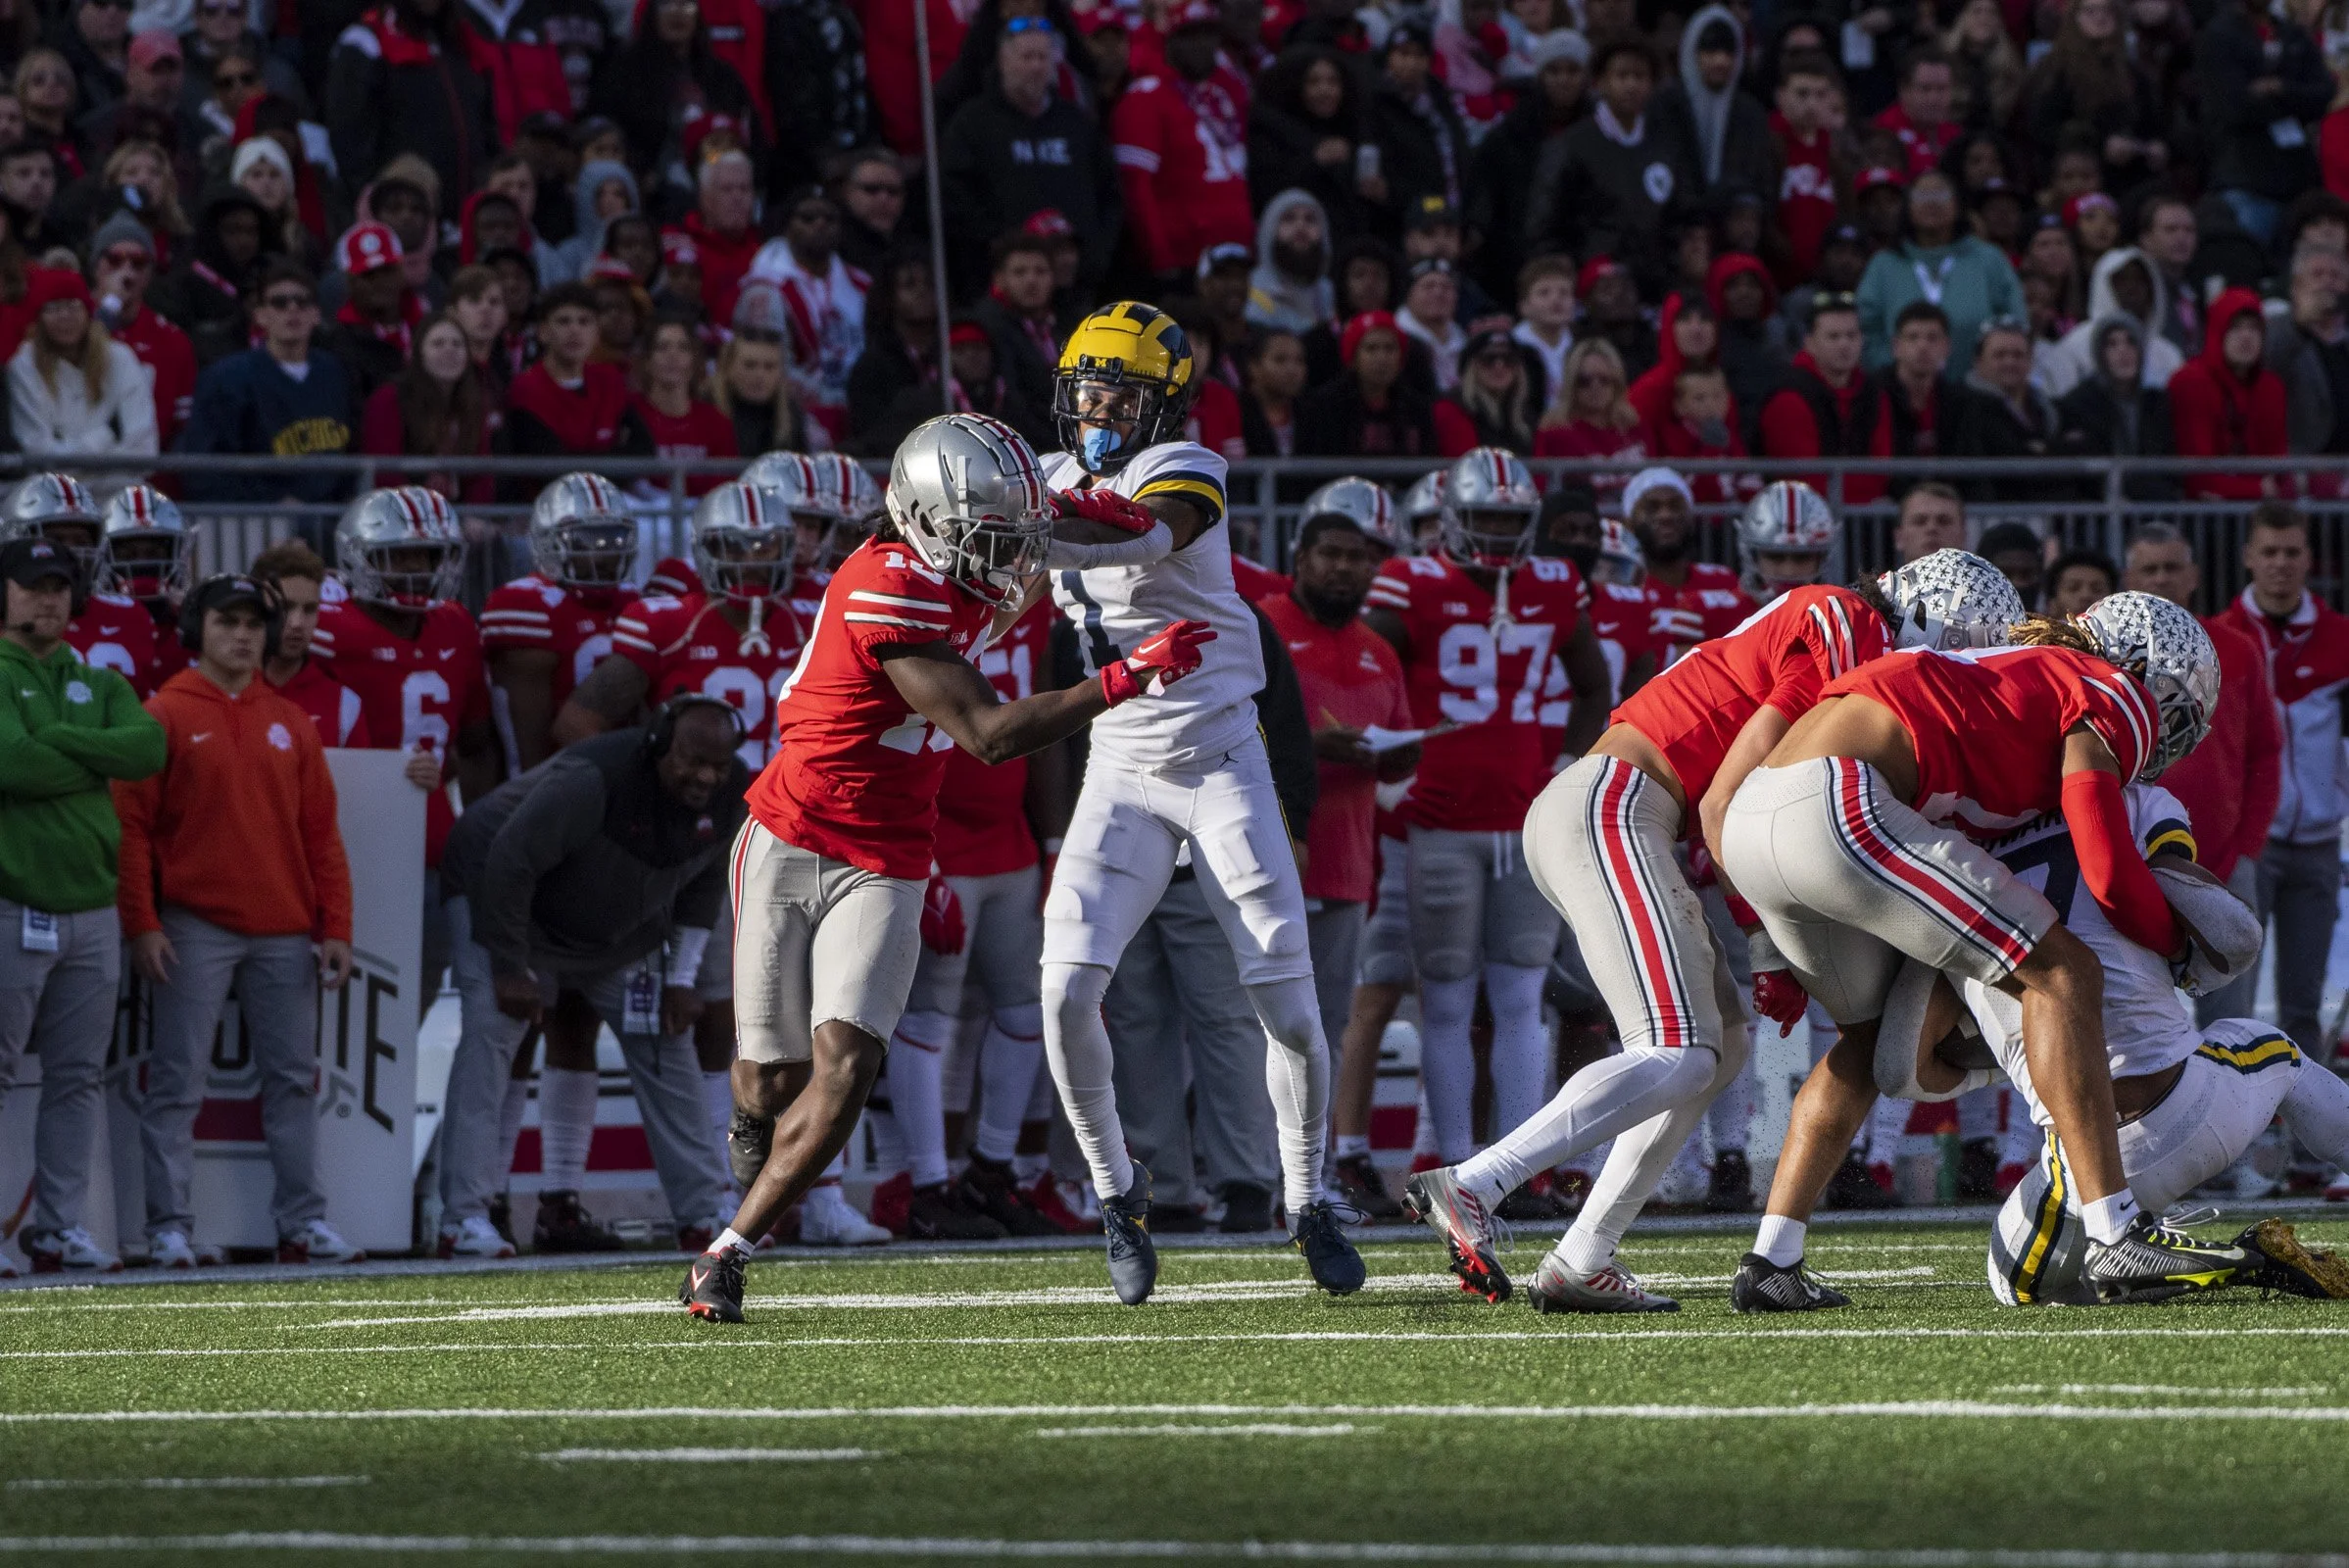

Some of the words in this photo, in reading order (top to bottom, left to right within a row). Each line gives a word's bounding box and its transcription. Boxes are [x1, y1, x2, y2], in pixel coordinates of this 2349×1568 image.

[1095, 358, 1107, 368] M
[1061, 569, 1124, 670] 1
[401, 669, 452, 771] 6
[1438, 622, 1556, 724] 97
